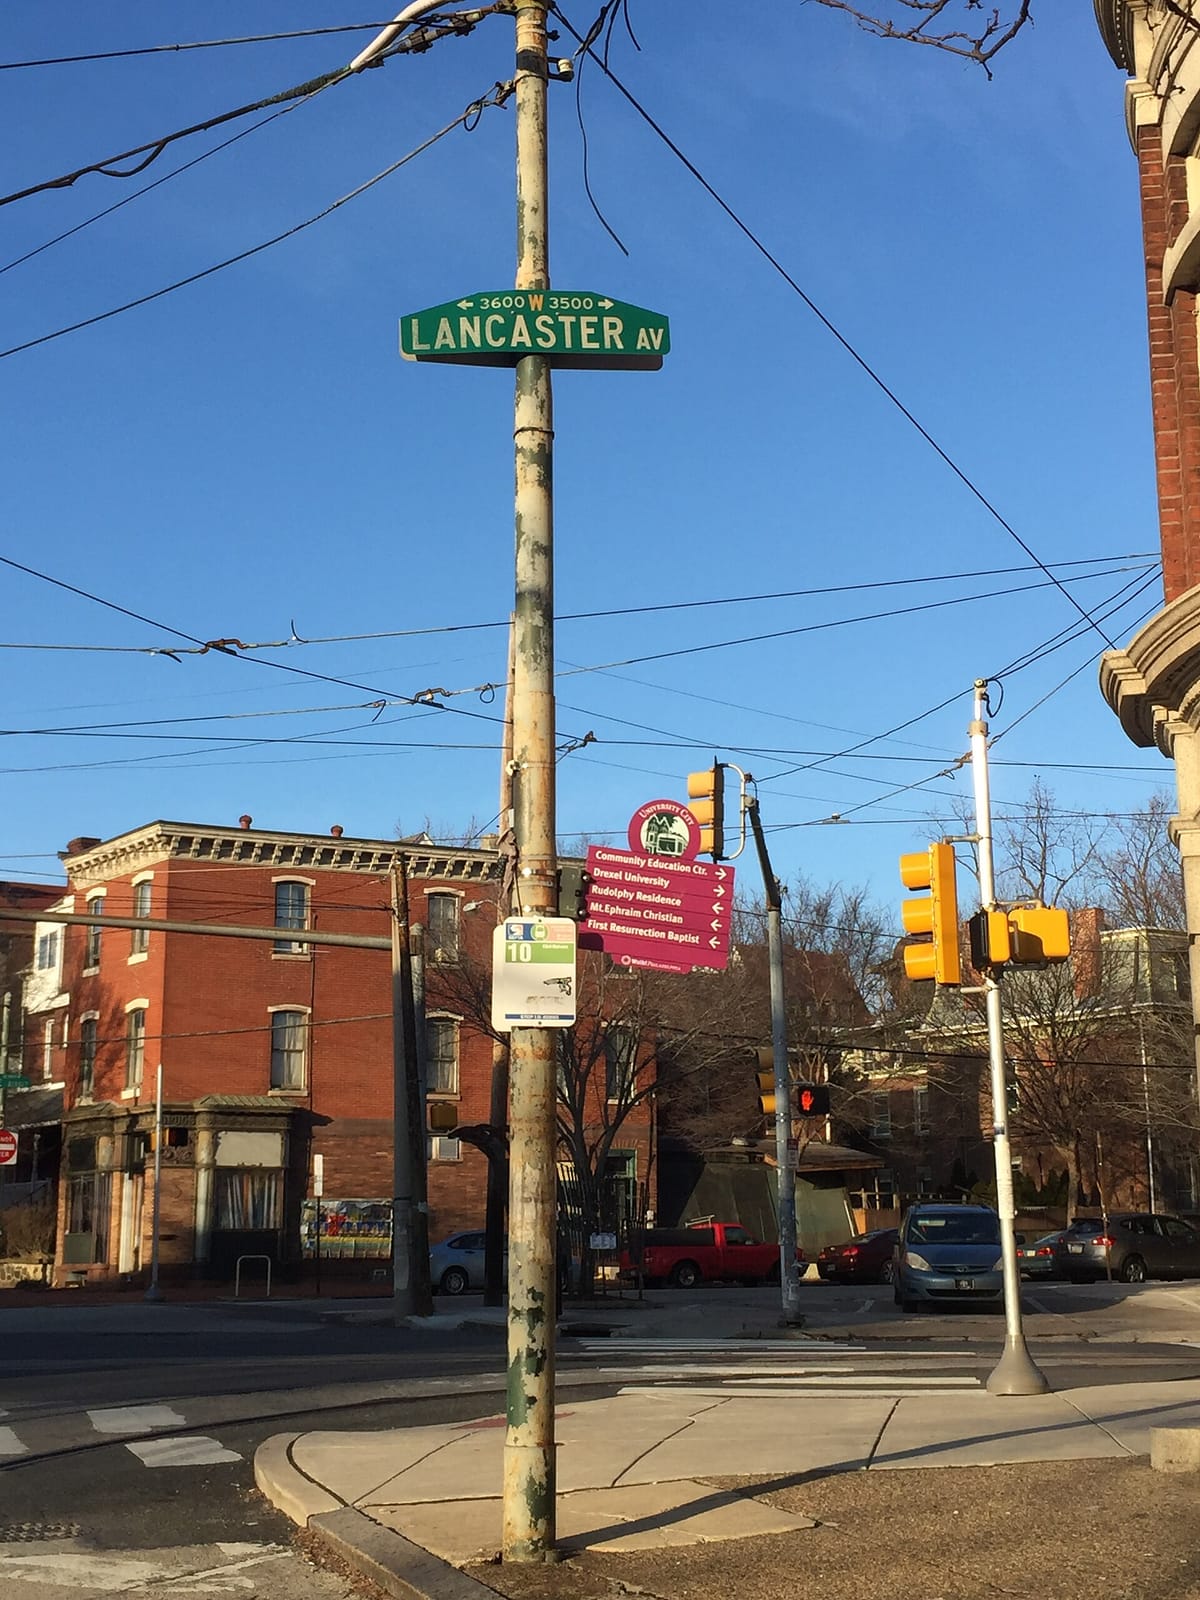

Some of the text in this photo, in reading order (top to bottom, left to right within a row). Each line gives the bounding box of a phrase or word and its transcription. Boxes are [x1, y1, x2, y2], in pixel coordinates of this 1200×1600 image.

[480, 295, 593, 311] 3600 W 3500
[411, 314, 664, 350] LANCASTER AV
[595, 850, 708, 876] Community Education Ctr.
[593, 868, 669, 889] Drexel University
[591, 885, 681, 906] Rudolphy Residence
[643, 909, 683, 923] Christian
[587, 919, 699, 944] First Resurrection Baptist
[508, 943, 531, 962] 10
